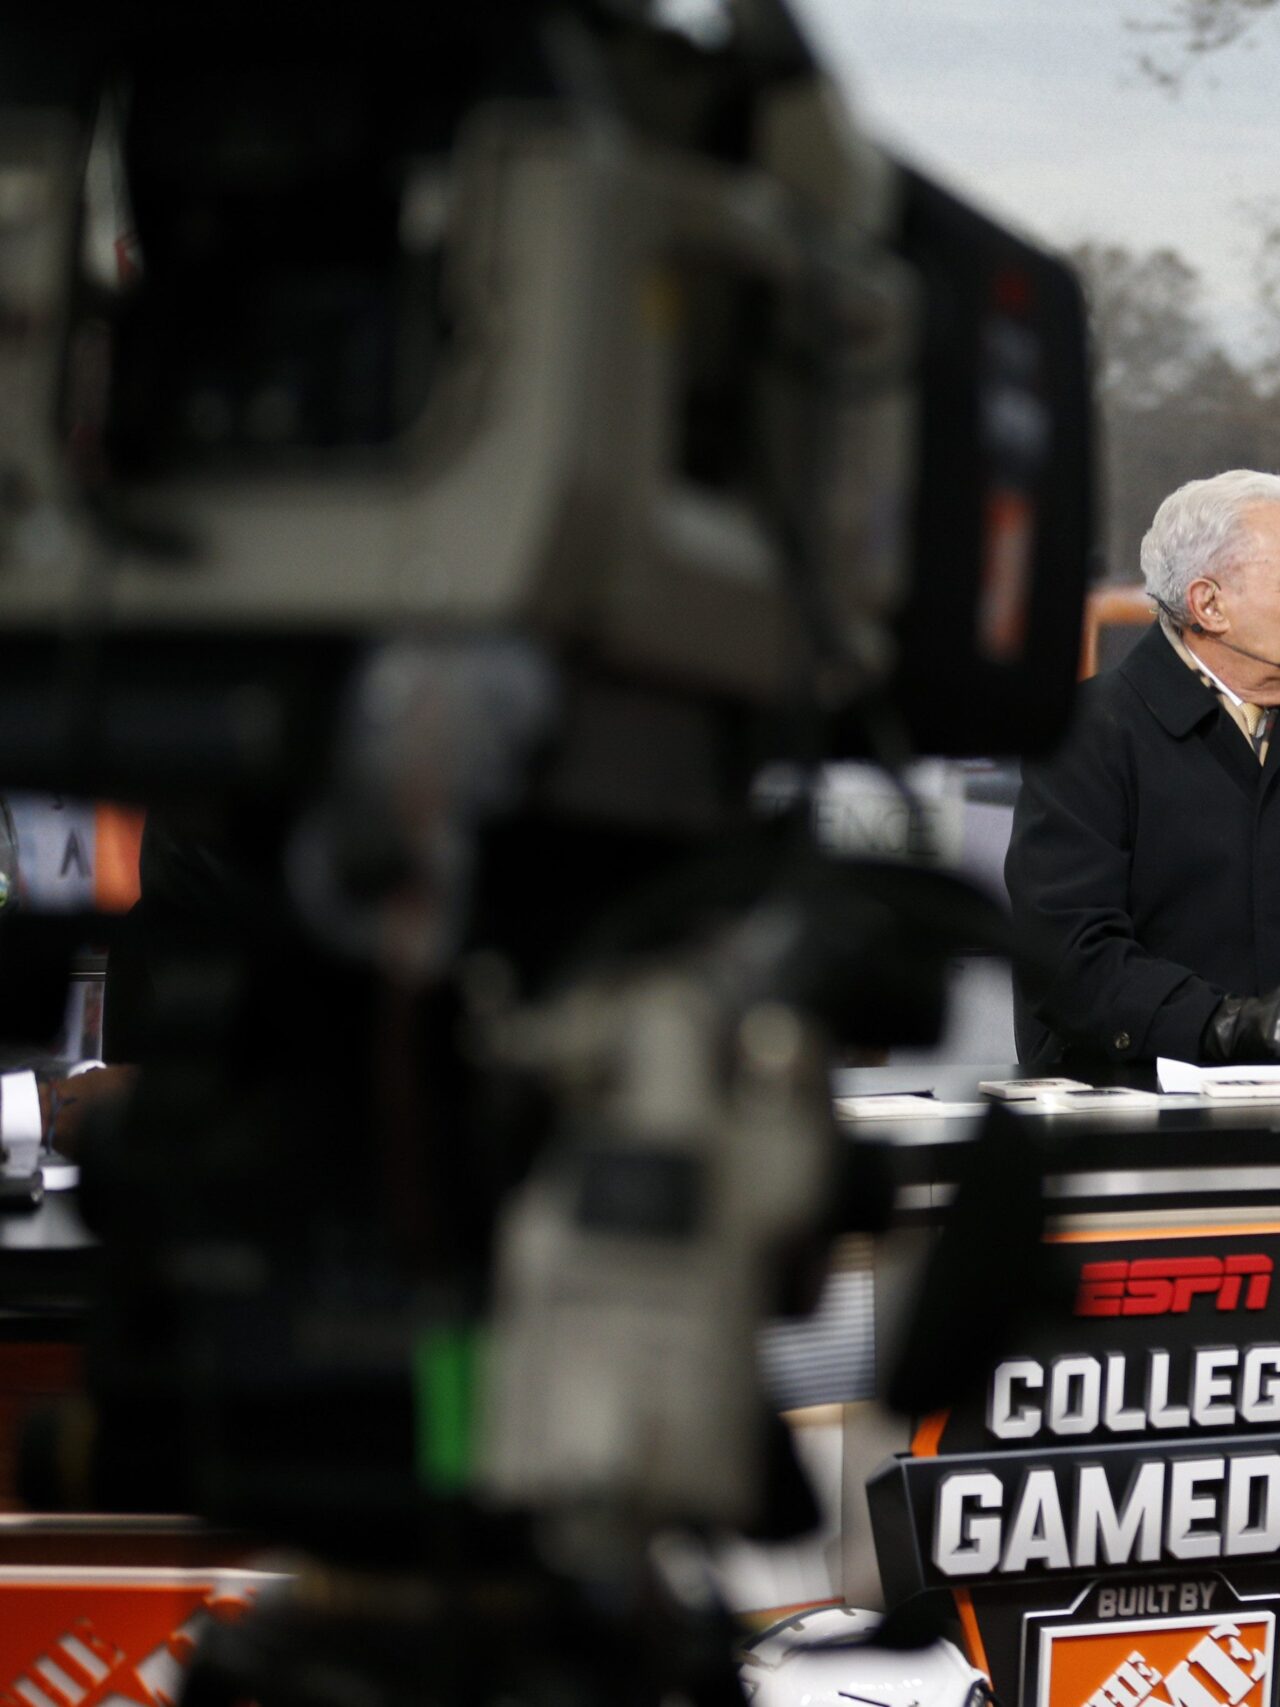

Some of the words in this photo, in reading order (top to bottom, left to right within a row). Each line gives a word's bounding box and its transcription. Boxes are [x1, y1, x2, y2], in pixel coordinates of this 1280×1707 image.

[1074, 1253, 1275, 1317] ESPN
[1097, 1583, 1176, 1619] BUILT
[1179, 1581, 1218, 1612] BY
